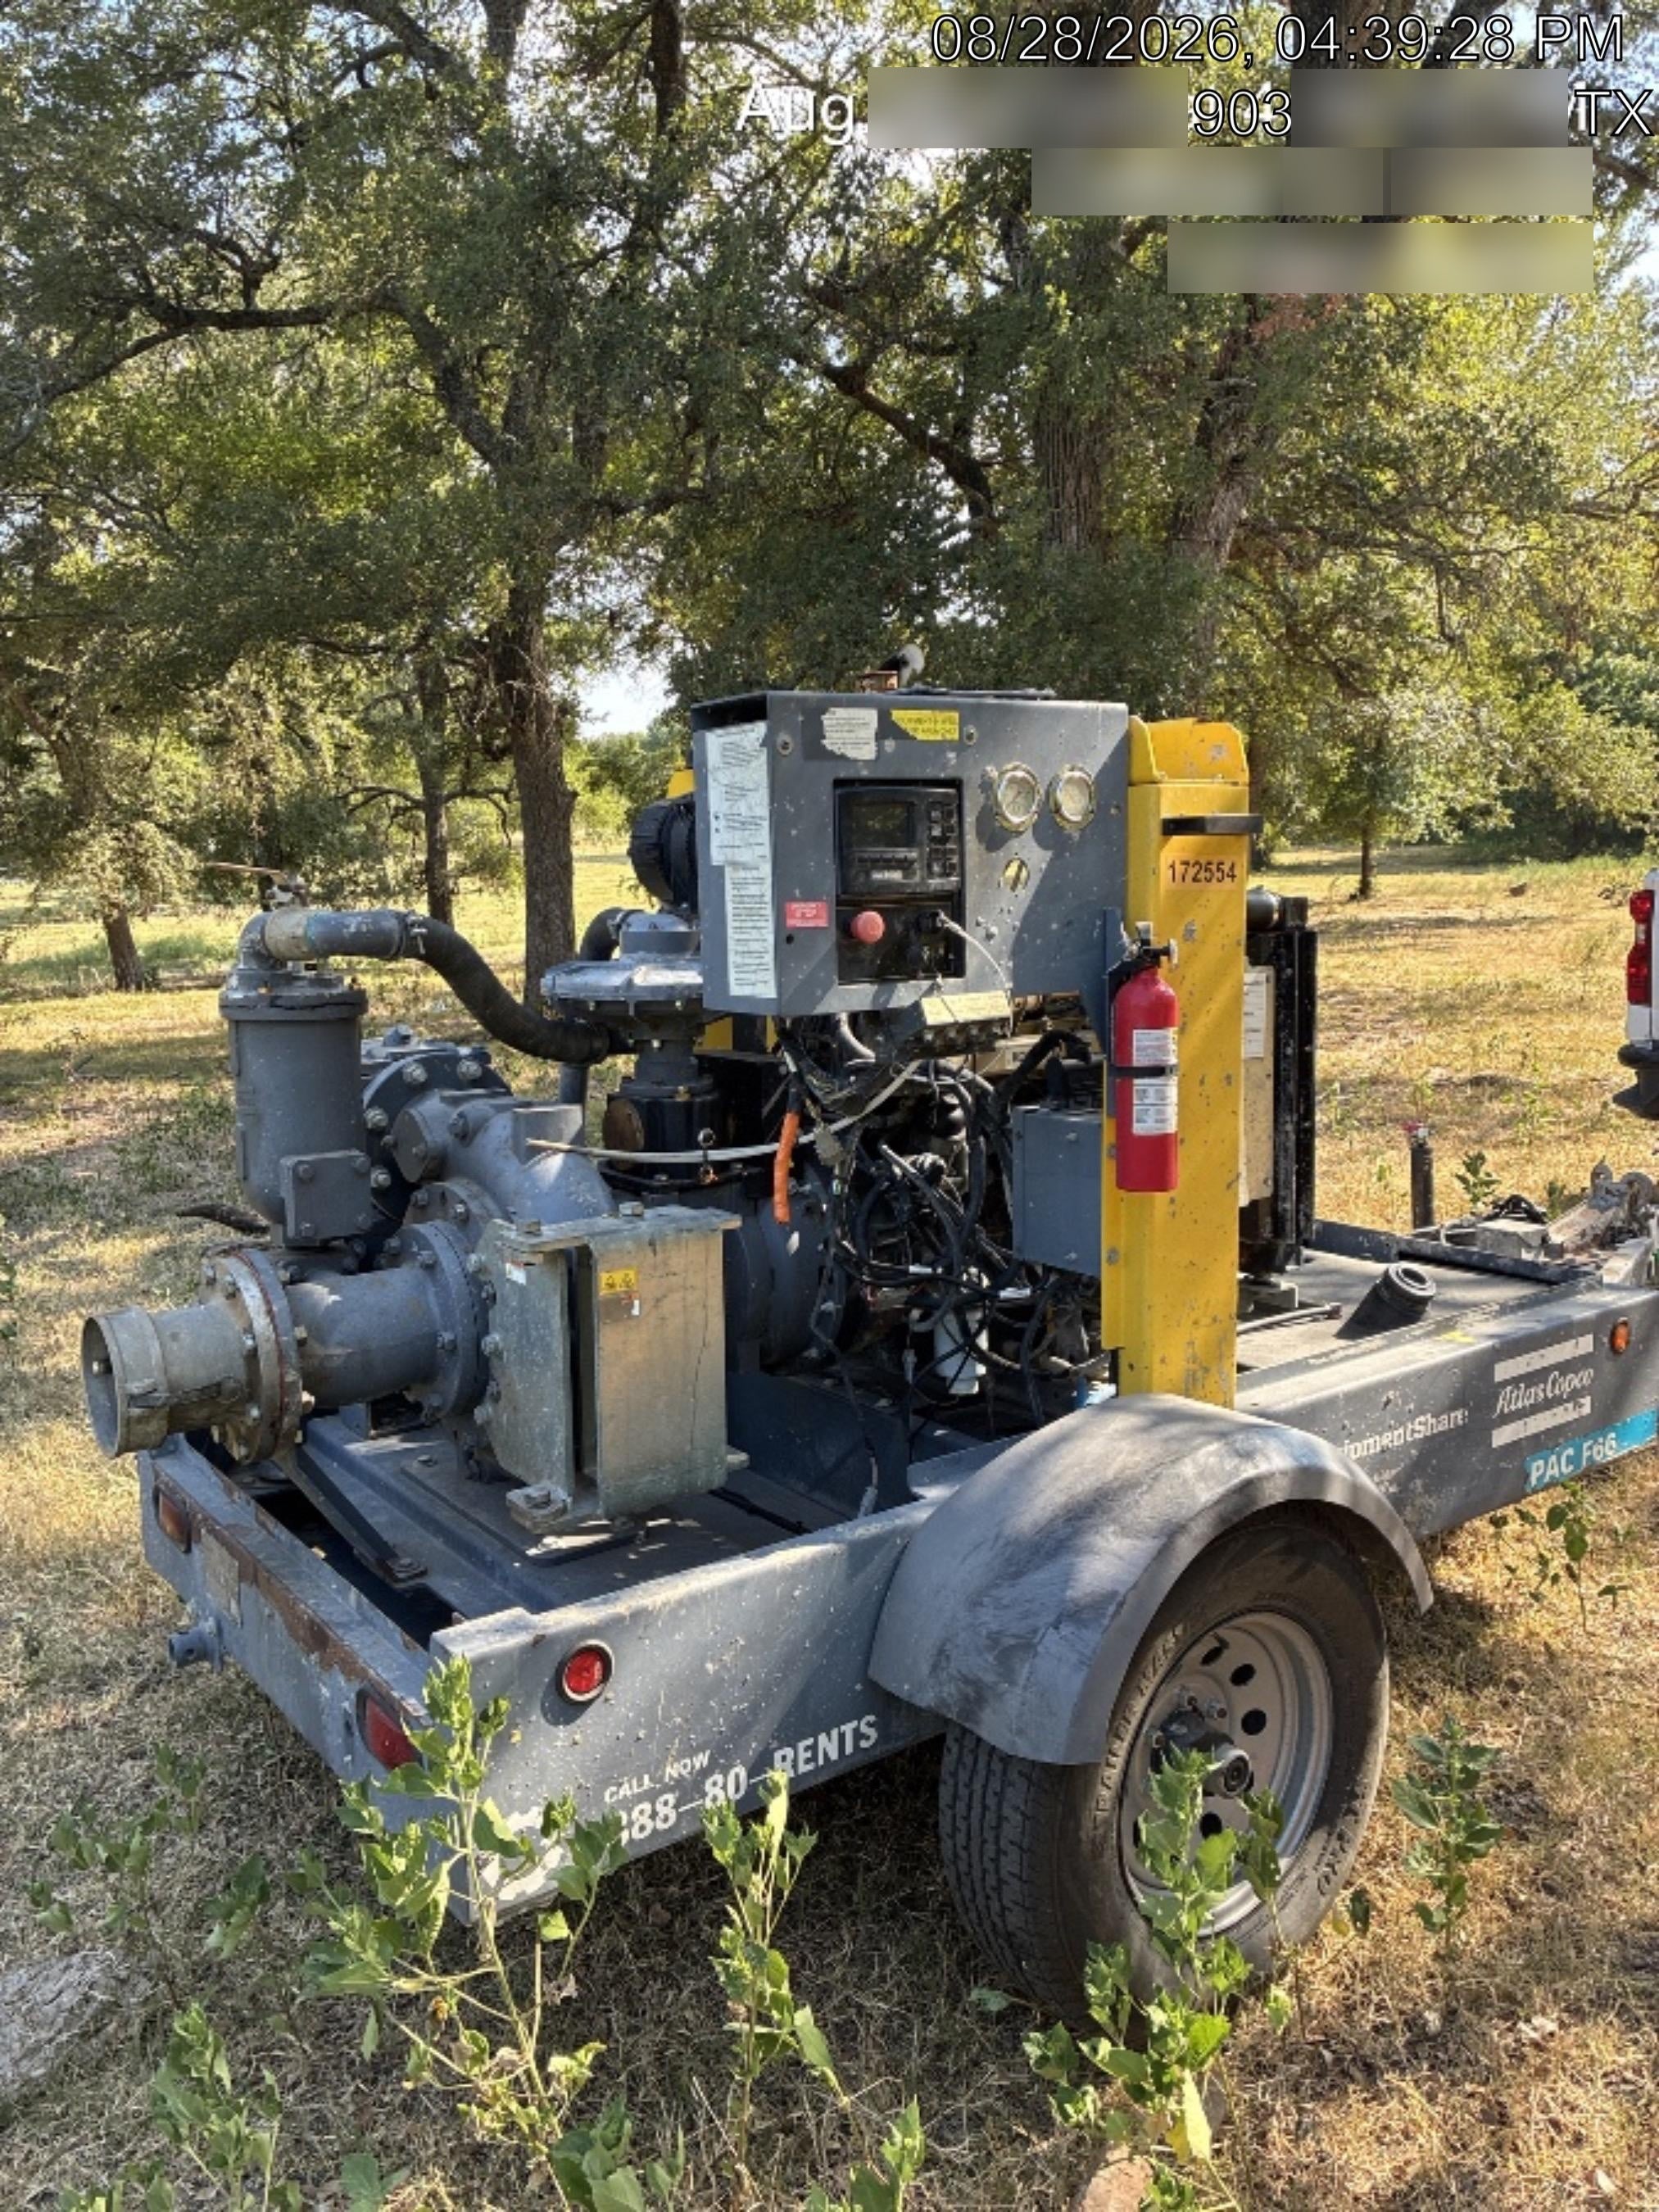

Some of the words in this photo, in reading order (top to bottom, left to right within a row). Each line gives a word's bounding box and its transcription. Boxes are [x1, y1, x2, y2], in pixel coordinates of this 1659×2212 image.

[1168, 859, 1237, 883] 172554
[1492, 1382, 1545, 1419] Atlas
[1545, 1369, 1594, 1399] Copco
[1530, 1447, 1575, 1487] PAC
[604, 1773, 660, 1803] CALL
[664, 1749, 711, 1783] NOW
